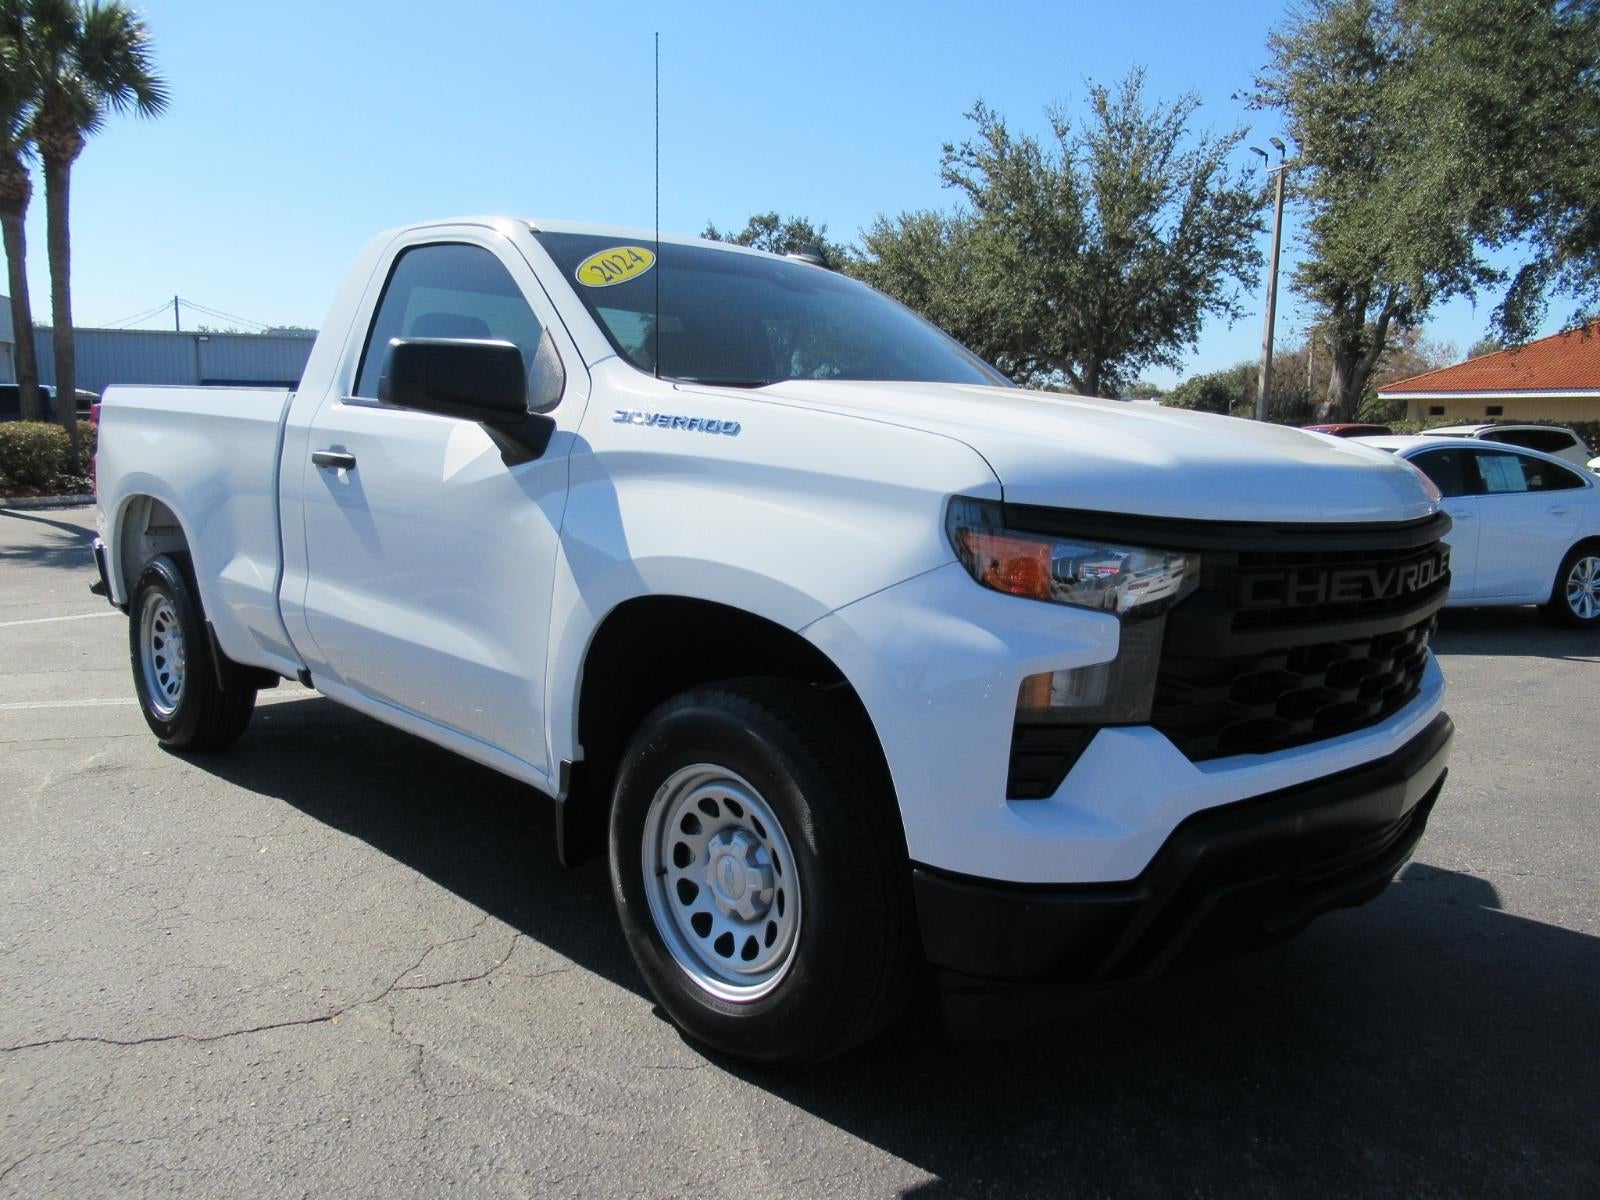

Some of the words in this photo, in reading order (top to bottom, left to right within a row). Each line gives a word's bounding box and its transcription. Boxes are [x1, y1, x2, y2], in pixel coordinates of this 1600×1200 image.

[591, 248, 645, 282] 2024
[612, 409, 742, 437] SILVERADO
[1241, 552, 1448, 606] CHEVROLE
